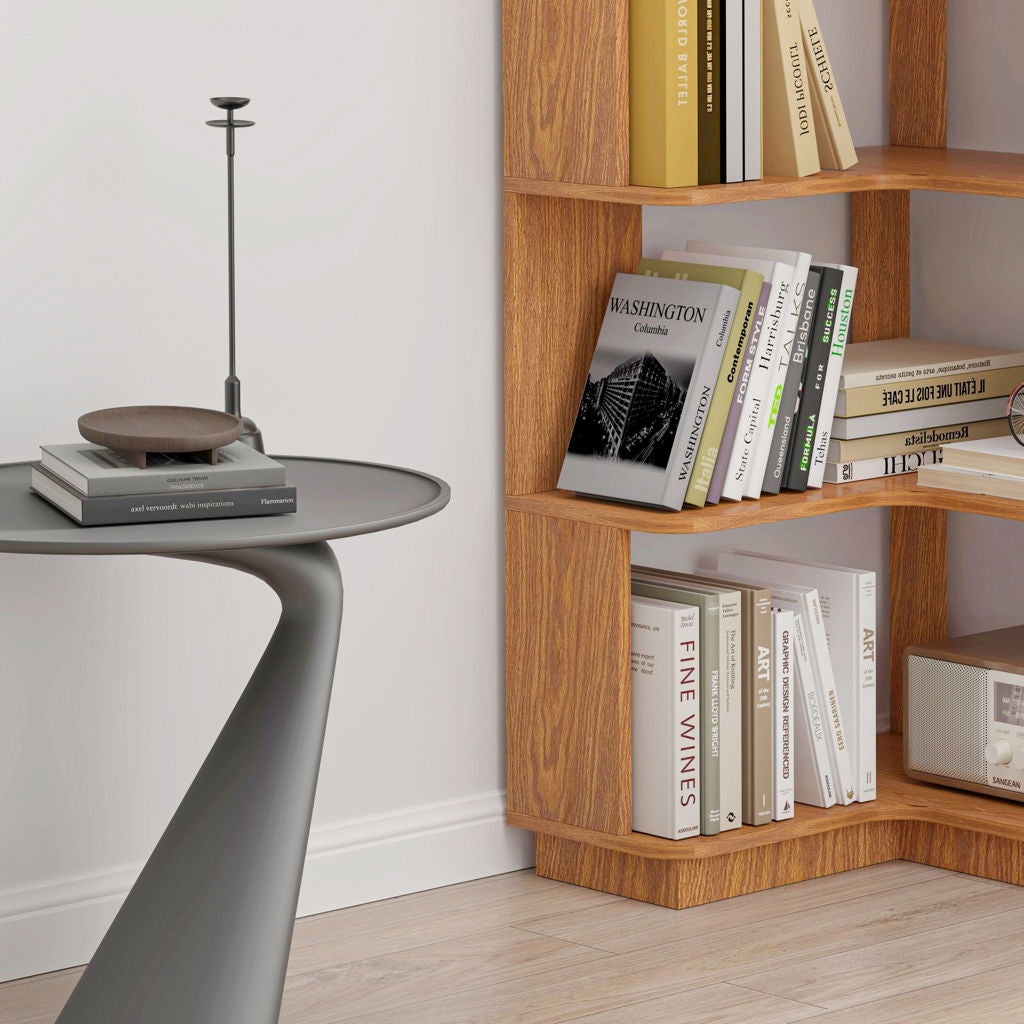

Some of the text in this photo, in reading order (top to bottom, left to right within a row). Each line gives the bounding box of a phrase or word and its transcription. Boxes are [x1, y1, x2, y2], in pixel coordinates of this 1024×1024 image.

[610, 297, 708, 324] WASHINGTON
[634, 322, 669, 336] Columbia
[758, 280, 790, 371] Harrisburg
[792, 288, 816, 363] Brisbane
[831, 289, 853, 357] Houston
[736, 305, 767, 404] FORM STYLE
[800, 288, 838, 471] FORMULA FOR SUCCESS
[678, 309, 731, 483] WASHINGTON Columbia
[767, 384, 783, 429] TED
[694, 447, 719, 493] Italia
[735, 397, 762, 483] State Capital
[773, 416, 790, 479] Queensland
[130, 500, 234, 513] axel vervoordt wabi inspirations
[260, 497, 294, 505] Flammarion
[757, 645, 770, 682] ART
[680, 640, 696, 808] FINE WINES
[782, 629, 790, 781] GRAPHIC DESIGN REFERENCED
[991, 776, 1021, 790] SANGEAN
